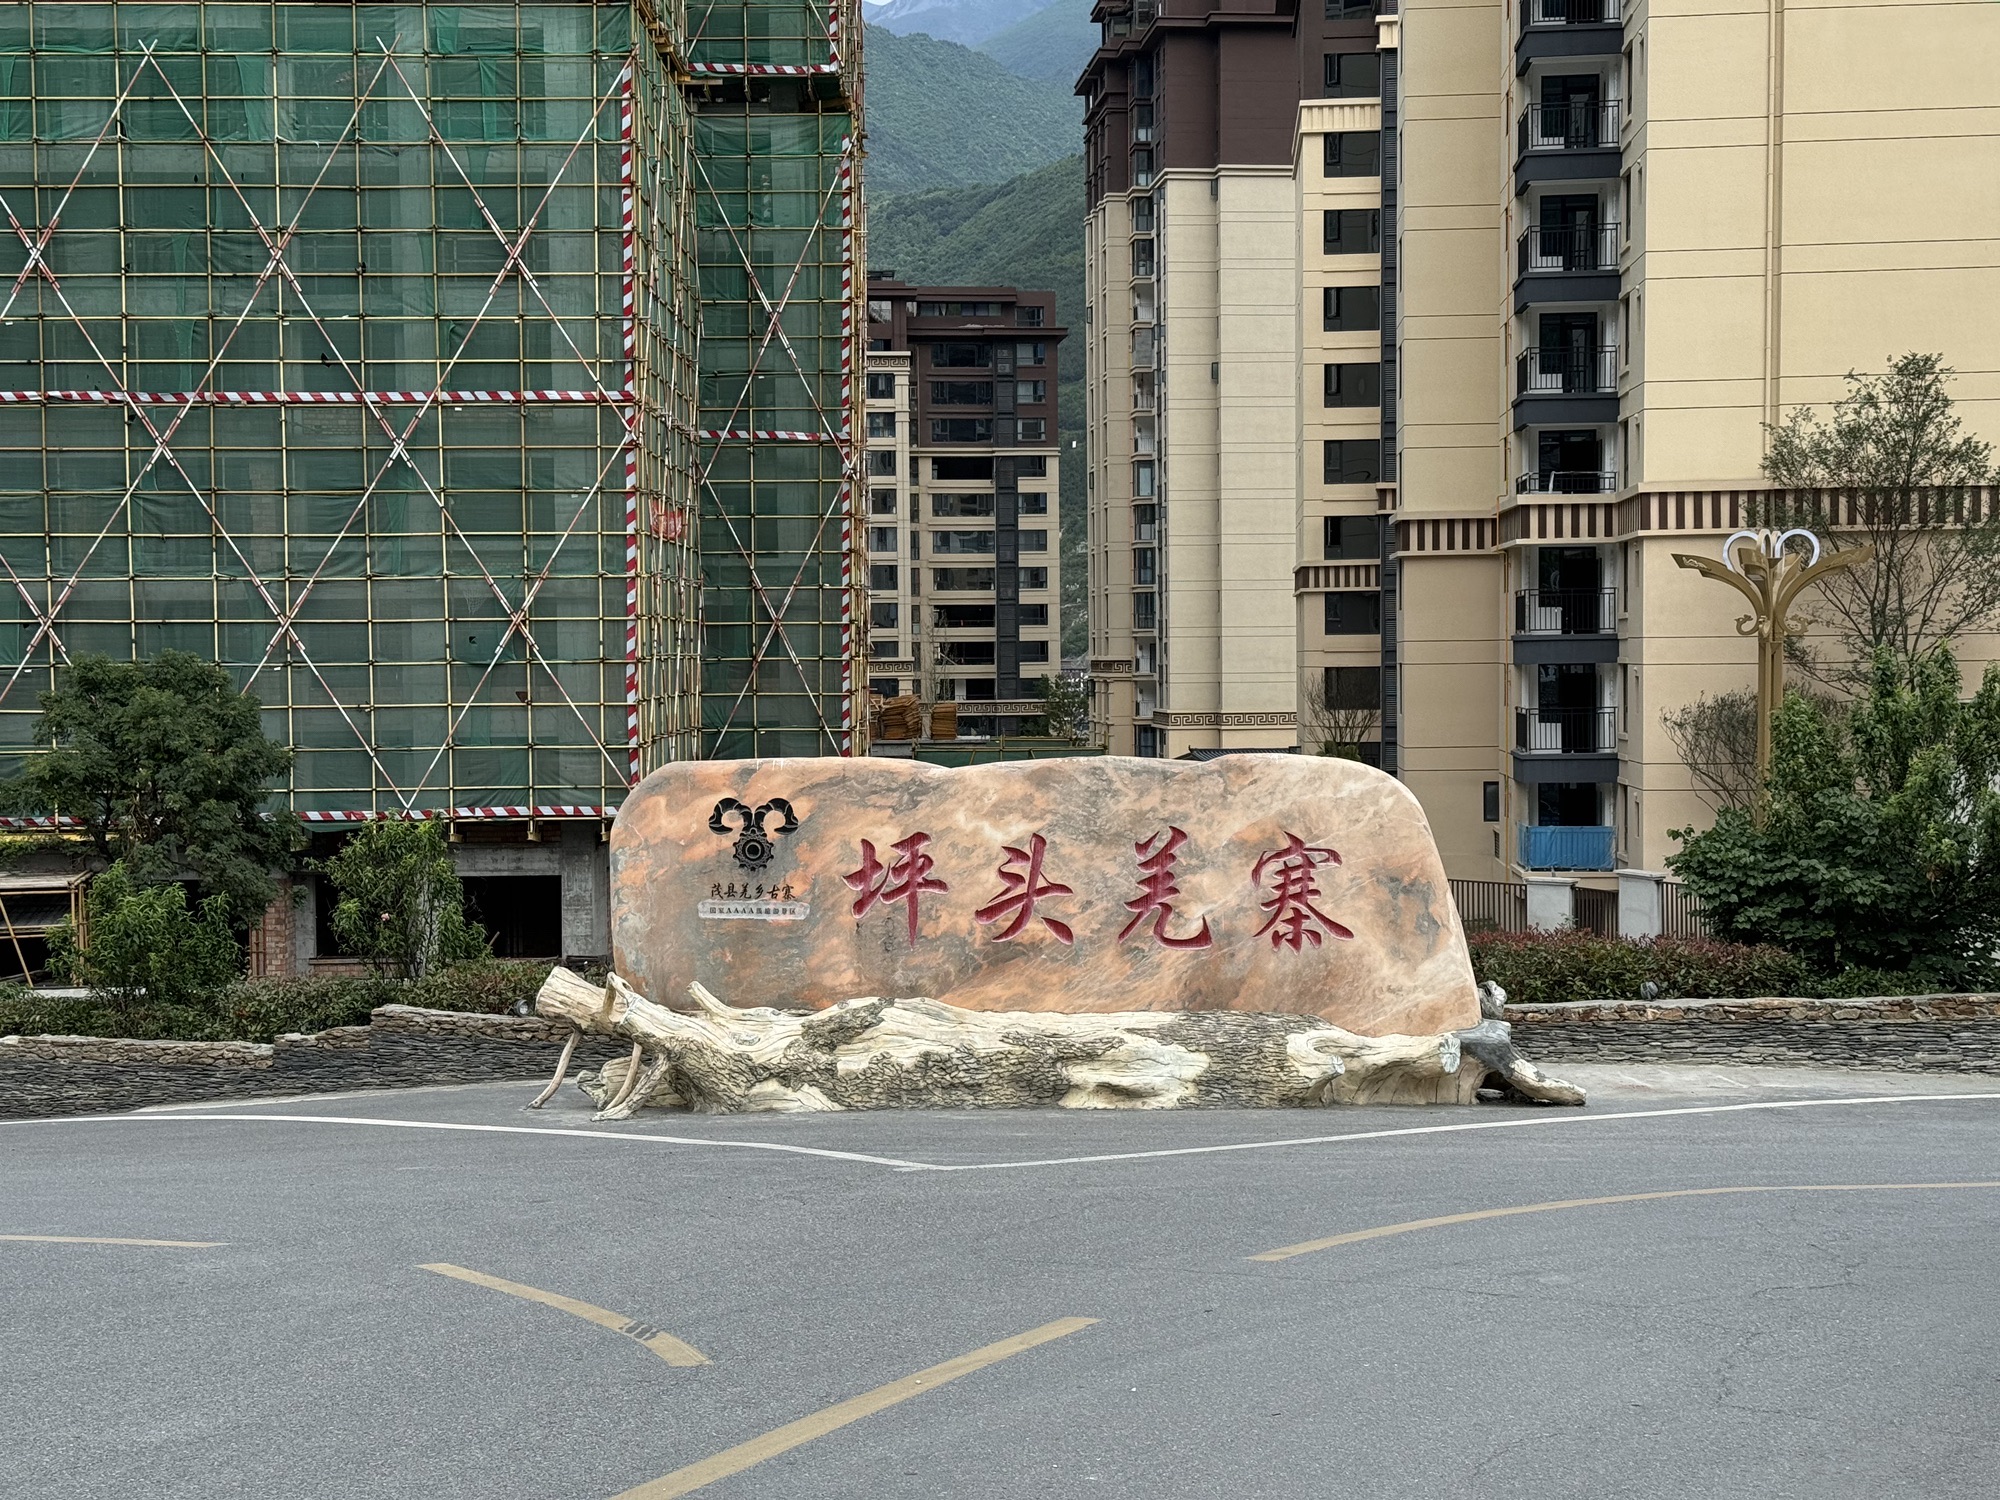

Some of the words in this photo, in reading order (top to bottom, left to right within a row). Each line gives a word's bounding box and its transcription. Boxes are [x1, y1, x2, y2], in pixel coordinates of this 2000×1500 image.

[711, 882, 796, 900] 茂县羌乡古寨
[842, 825, 1355, 954] 坪头羌寨
